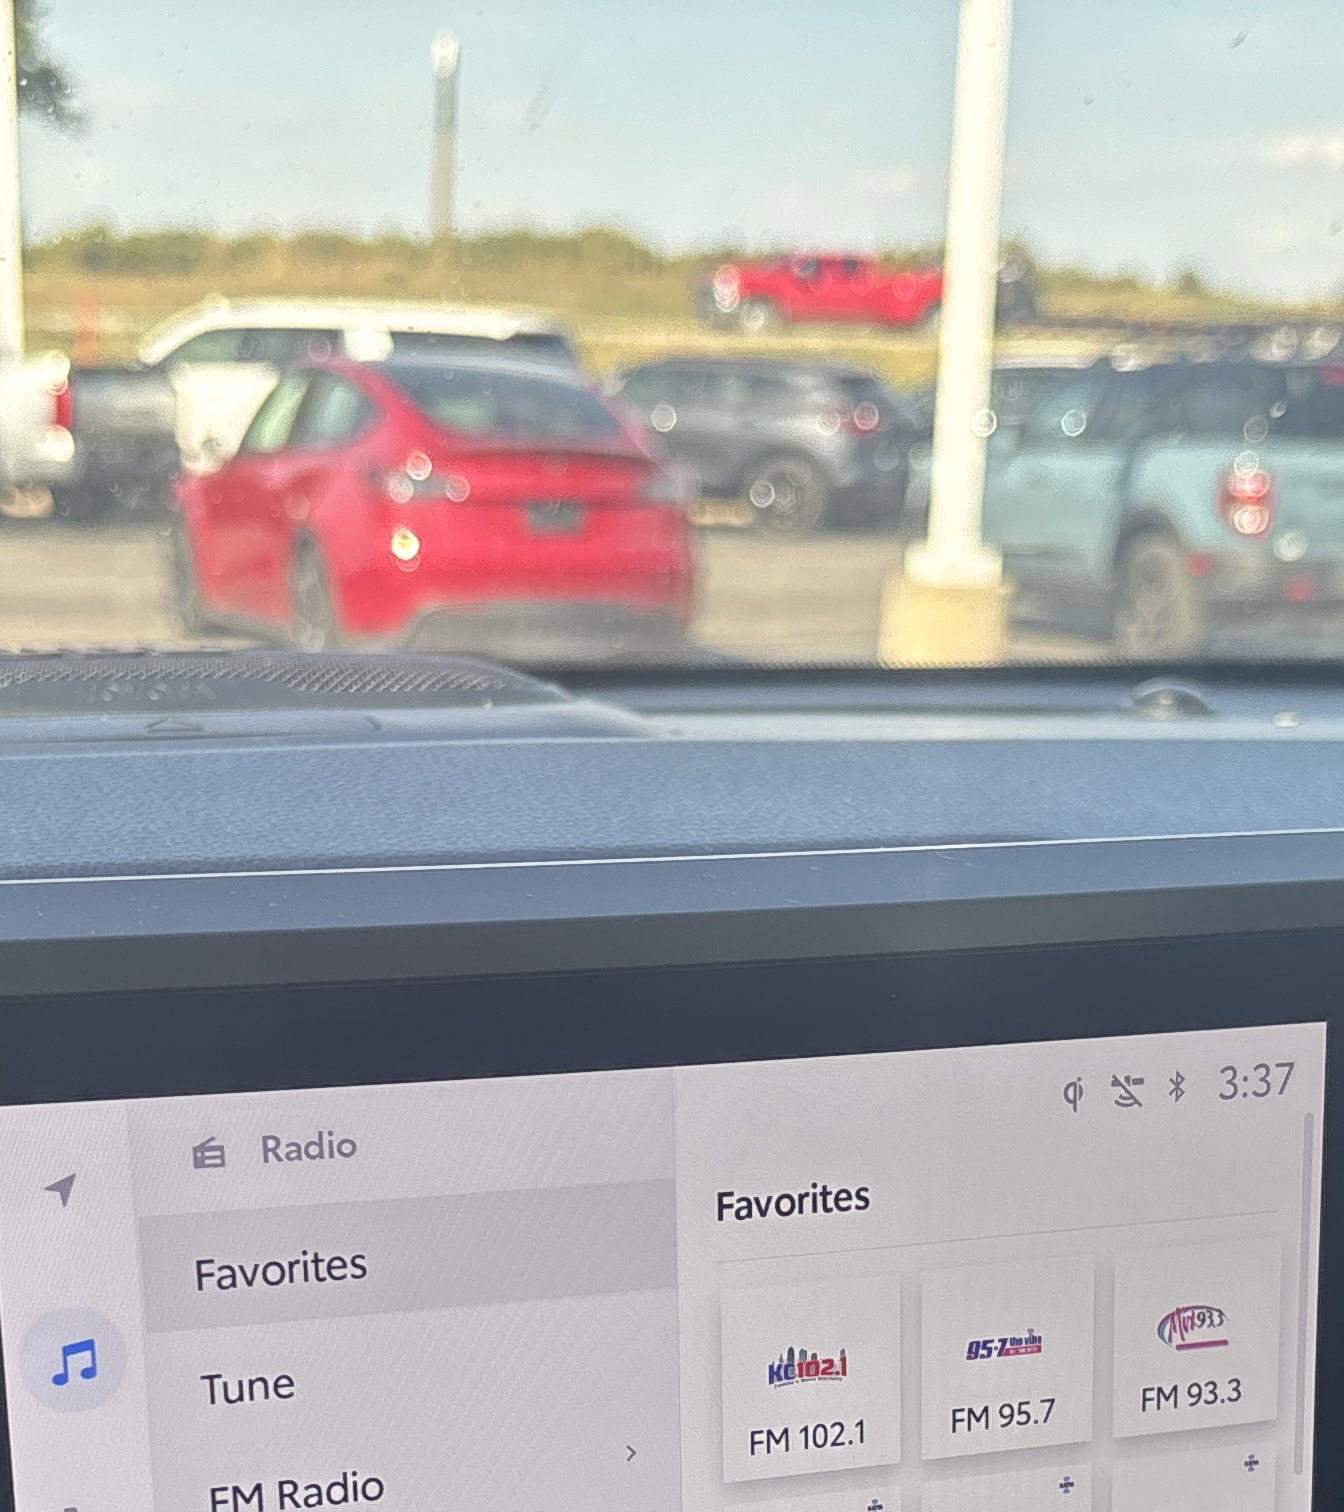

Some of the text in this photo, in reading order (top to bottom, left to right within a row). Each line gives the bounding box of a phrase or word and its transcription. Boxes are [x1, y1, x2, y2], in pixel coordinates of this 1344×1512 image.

[1218, 1061, 1295, 1101] 3:37
[261, 1129, 358, 1164] Radio
[717, 1182, 870, 1222] Favorites
[195, 1249, 368, 1291] Favorites
[200, 1373, 295, 1405] Tune
[1141, 1378, 1242, 1413] FM 93.3
[951, 1397, 1056, 1434] FM 95.7
[750, 1418, 864, 1456] FM 102.1
[278, 1470, 385, 1511] Radio
